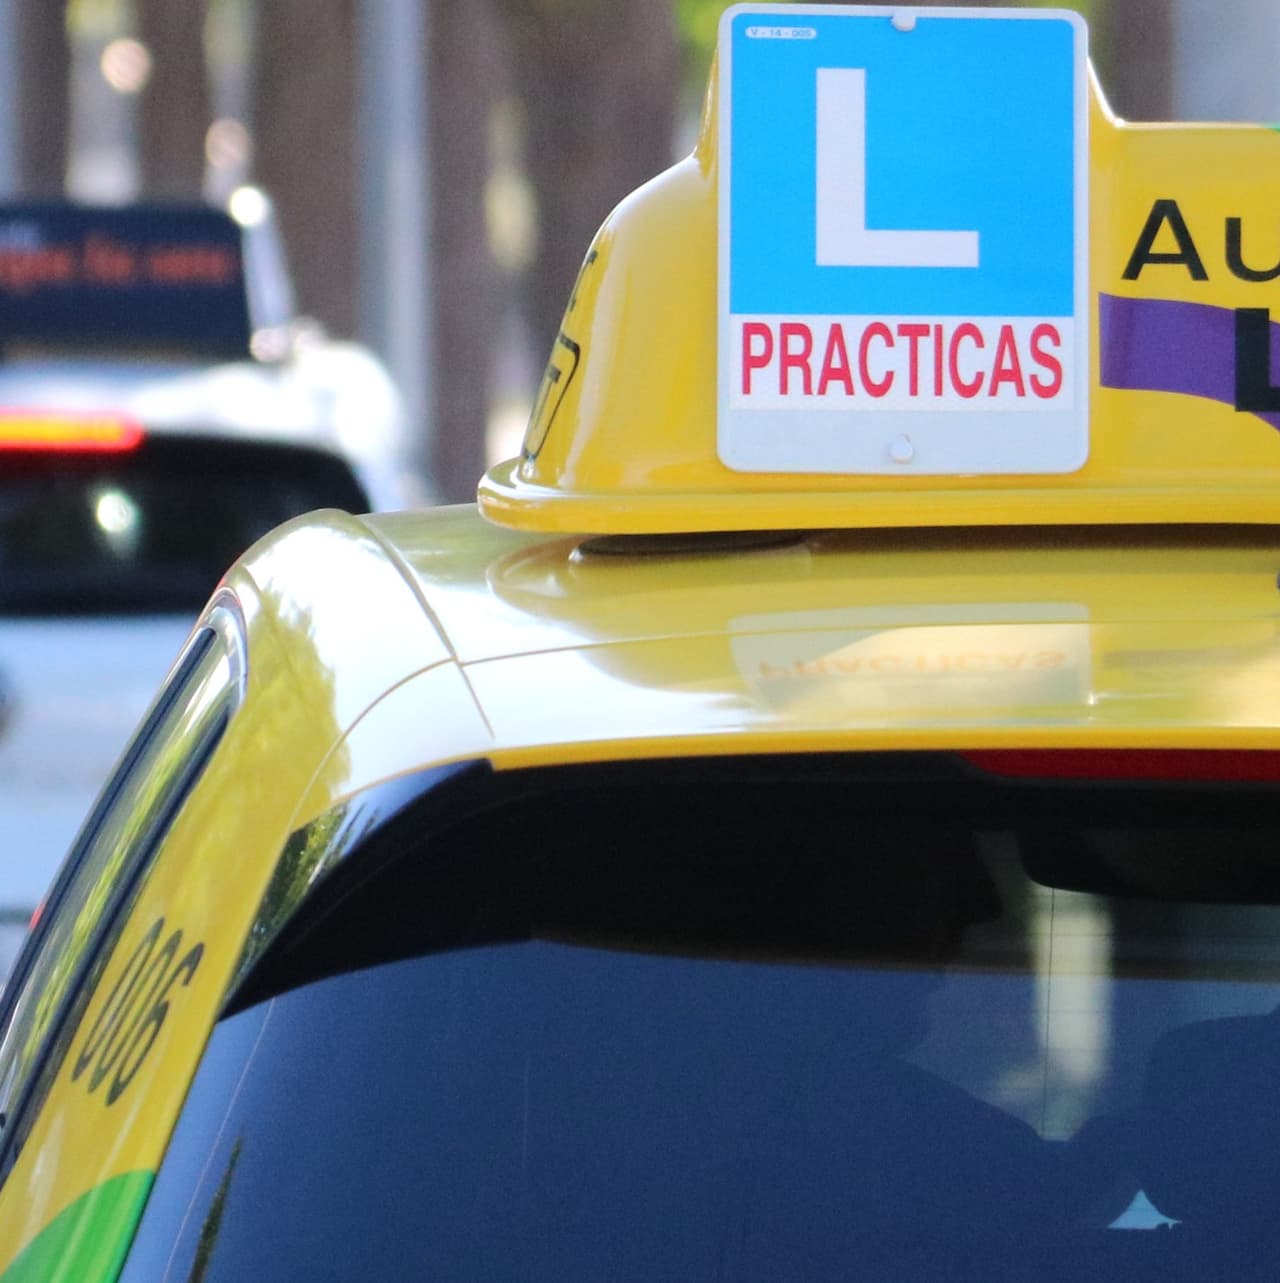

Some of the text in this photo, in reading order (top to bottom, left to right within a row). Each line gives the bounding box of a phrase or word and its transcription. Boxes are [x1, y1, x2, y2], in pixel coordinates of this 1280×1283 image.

[817, 69, 979, 267] L
[741, 322, 1063, 399] PRACTICAS
[72, 916, 205, 1108] 006
